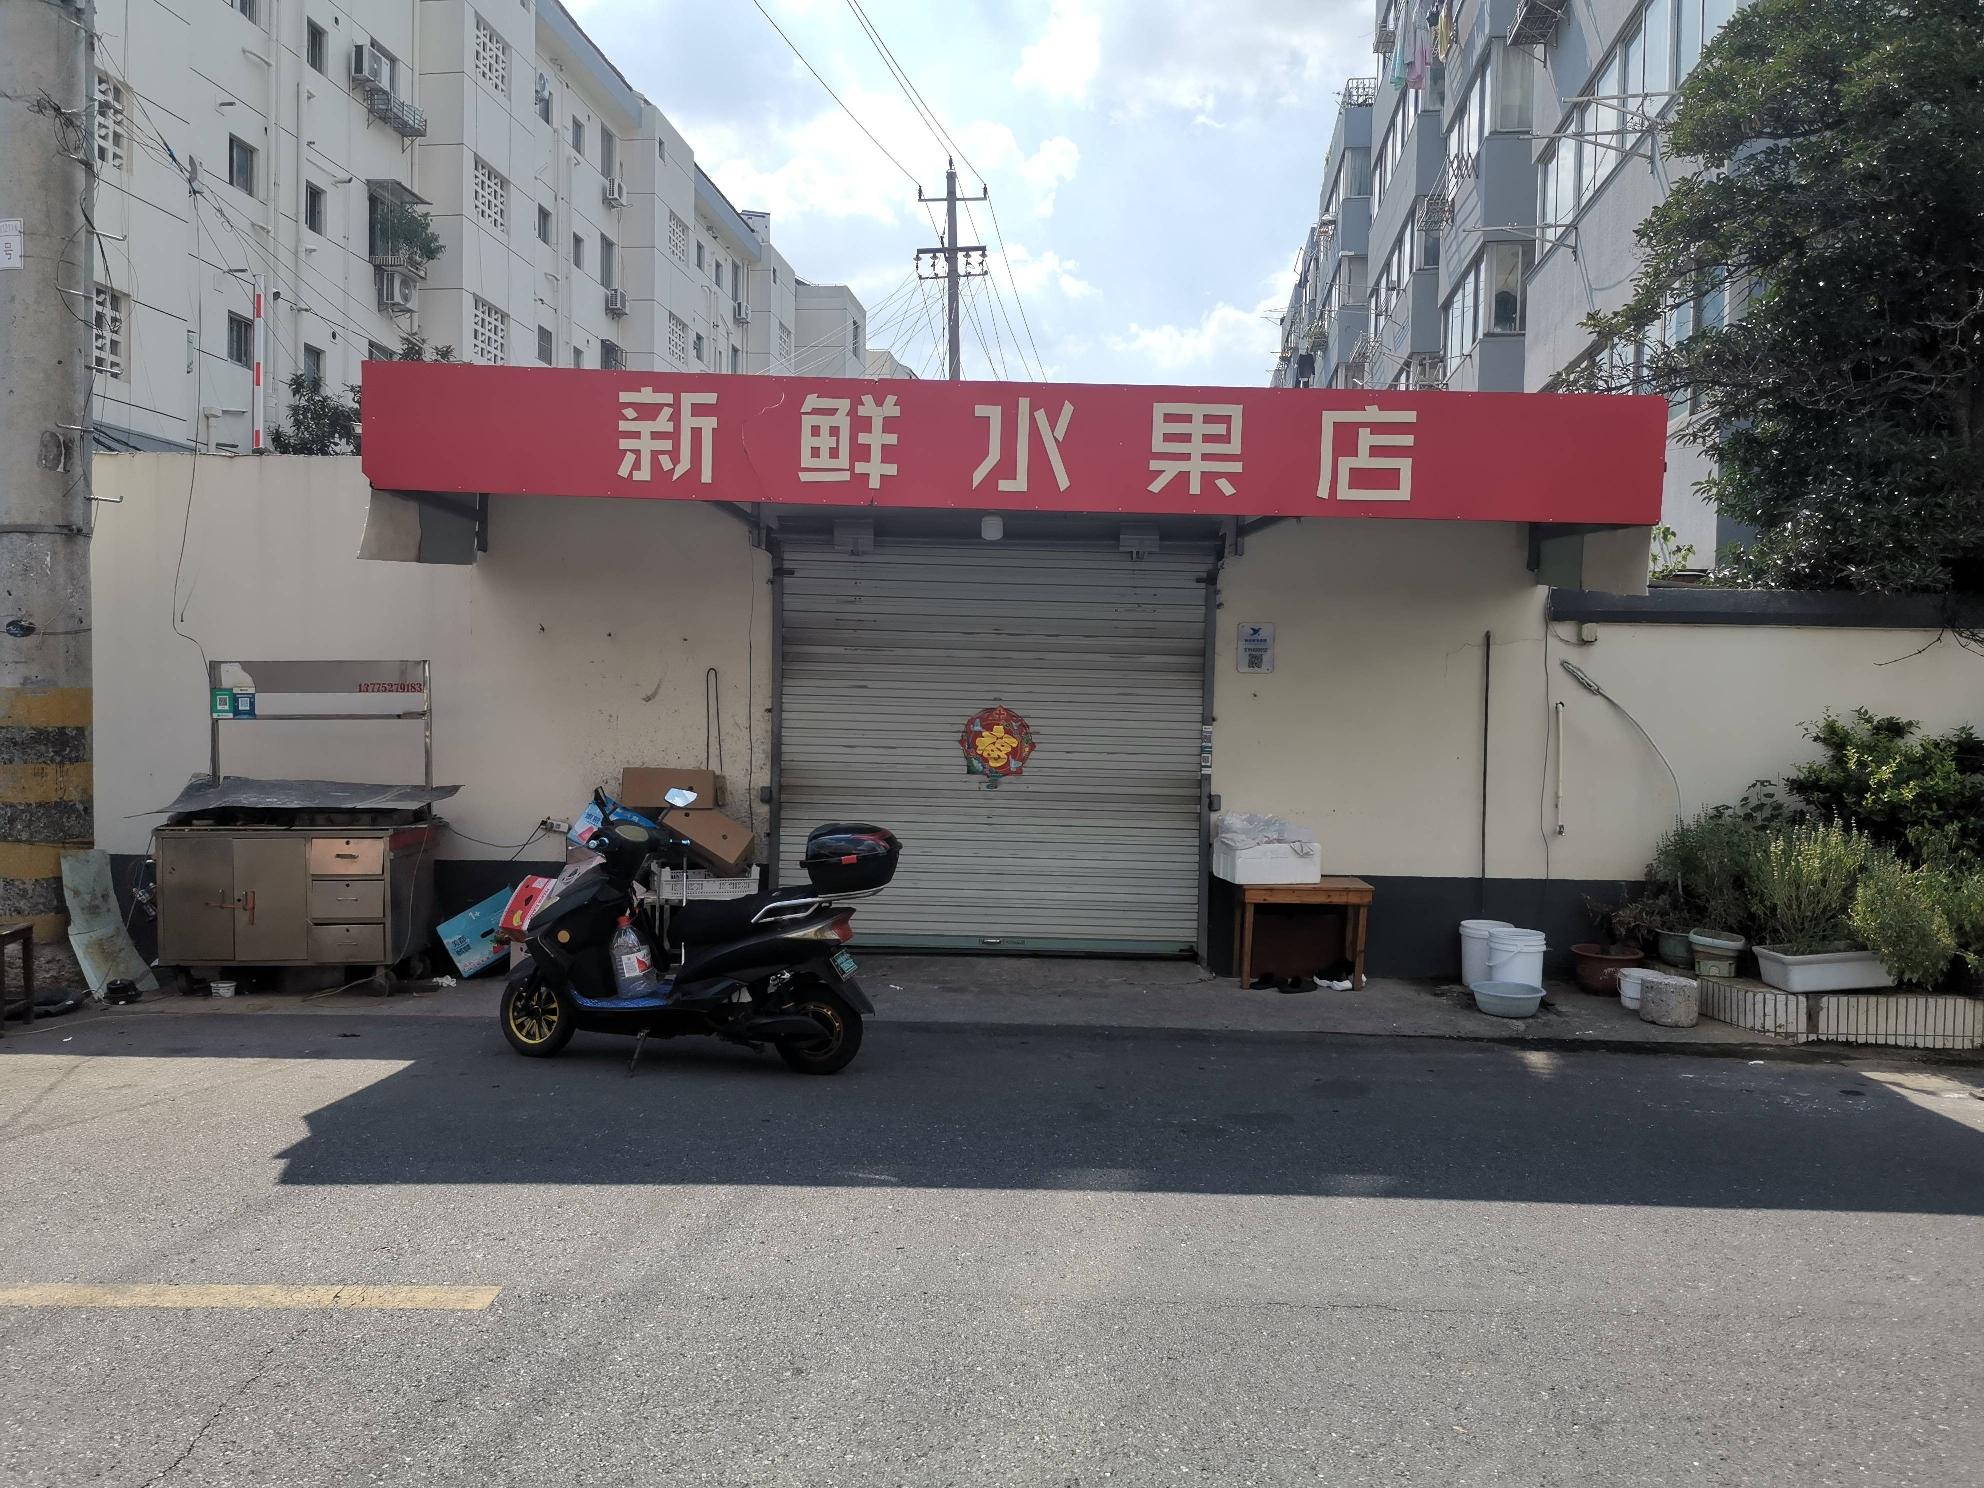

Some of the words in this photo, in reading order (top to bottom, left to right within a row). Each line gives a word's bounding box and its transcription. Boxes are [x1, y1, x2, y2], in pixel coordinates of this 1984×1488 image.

[617, 387, 1417, 502] 新鲜水果店
